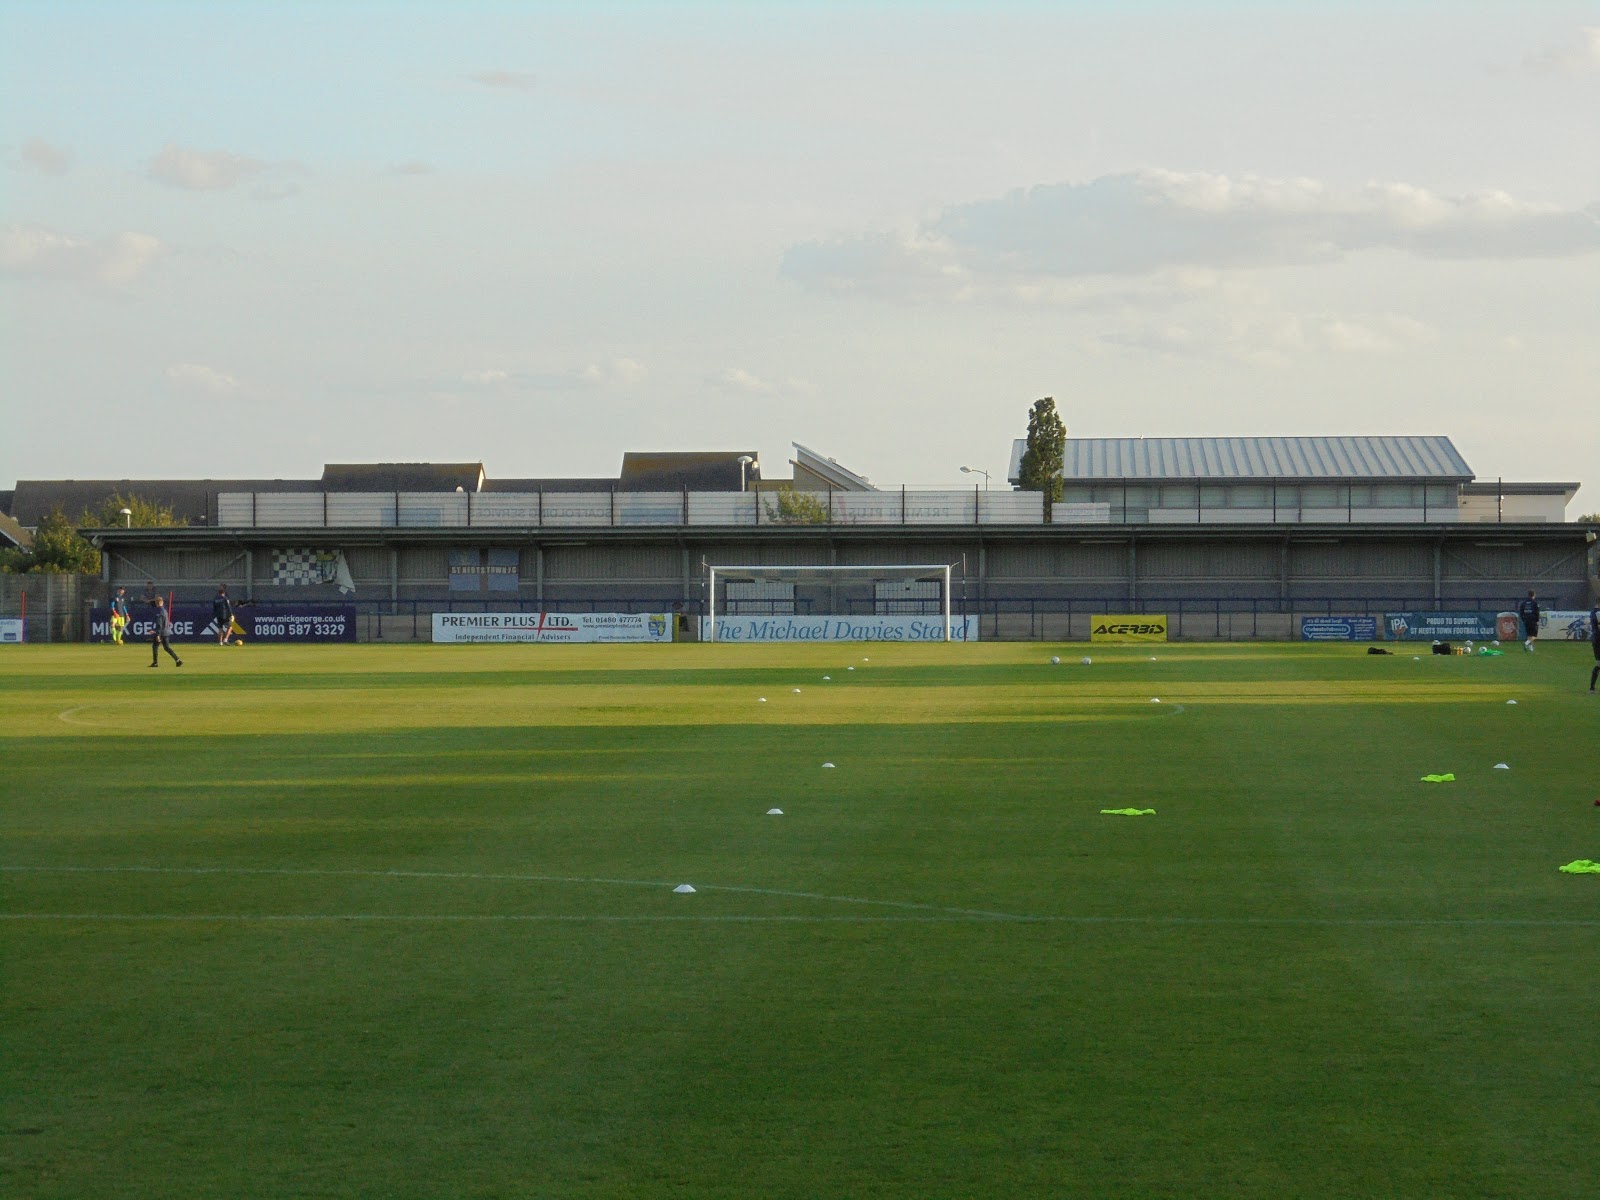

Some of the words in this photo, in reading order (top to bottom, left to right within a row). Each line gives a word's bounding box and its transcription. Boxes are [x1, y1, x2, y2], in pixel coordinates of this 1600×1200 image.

[254, 615, 346, 624] www.mickgeorge.co.uk
[441, 616, 500, 627] PREMIER
[503, 616, 536, 627] PLUS
[548, 616, 573, 627] LTD.
[1390, 617, 1408, 630] IPA
[1426, 617, 1444, 625] PROUD
[1445, 617, 1453, 625] TO
[1453, 617, 1478, 625] SUPPORT
[92, 622, 130, 636] MIK
[254, 624, 285, 636] 0800
[288, 624, 311, 636] 587
[314, 624, 345, 636] 3329
[746, 620, 829, 640] Michael
[835, 620, 904, 640] Davies
[1453, 627, 1479, 635] FOOTBALL
[455, 633, 500, 641] Independent
